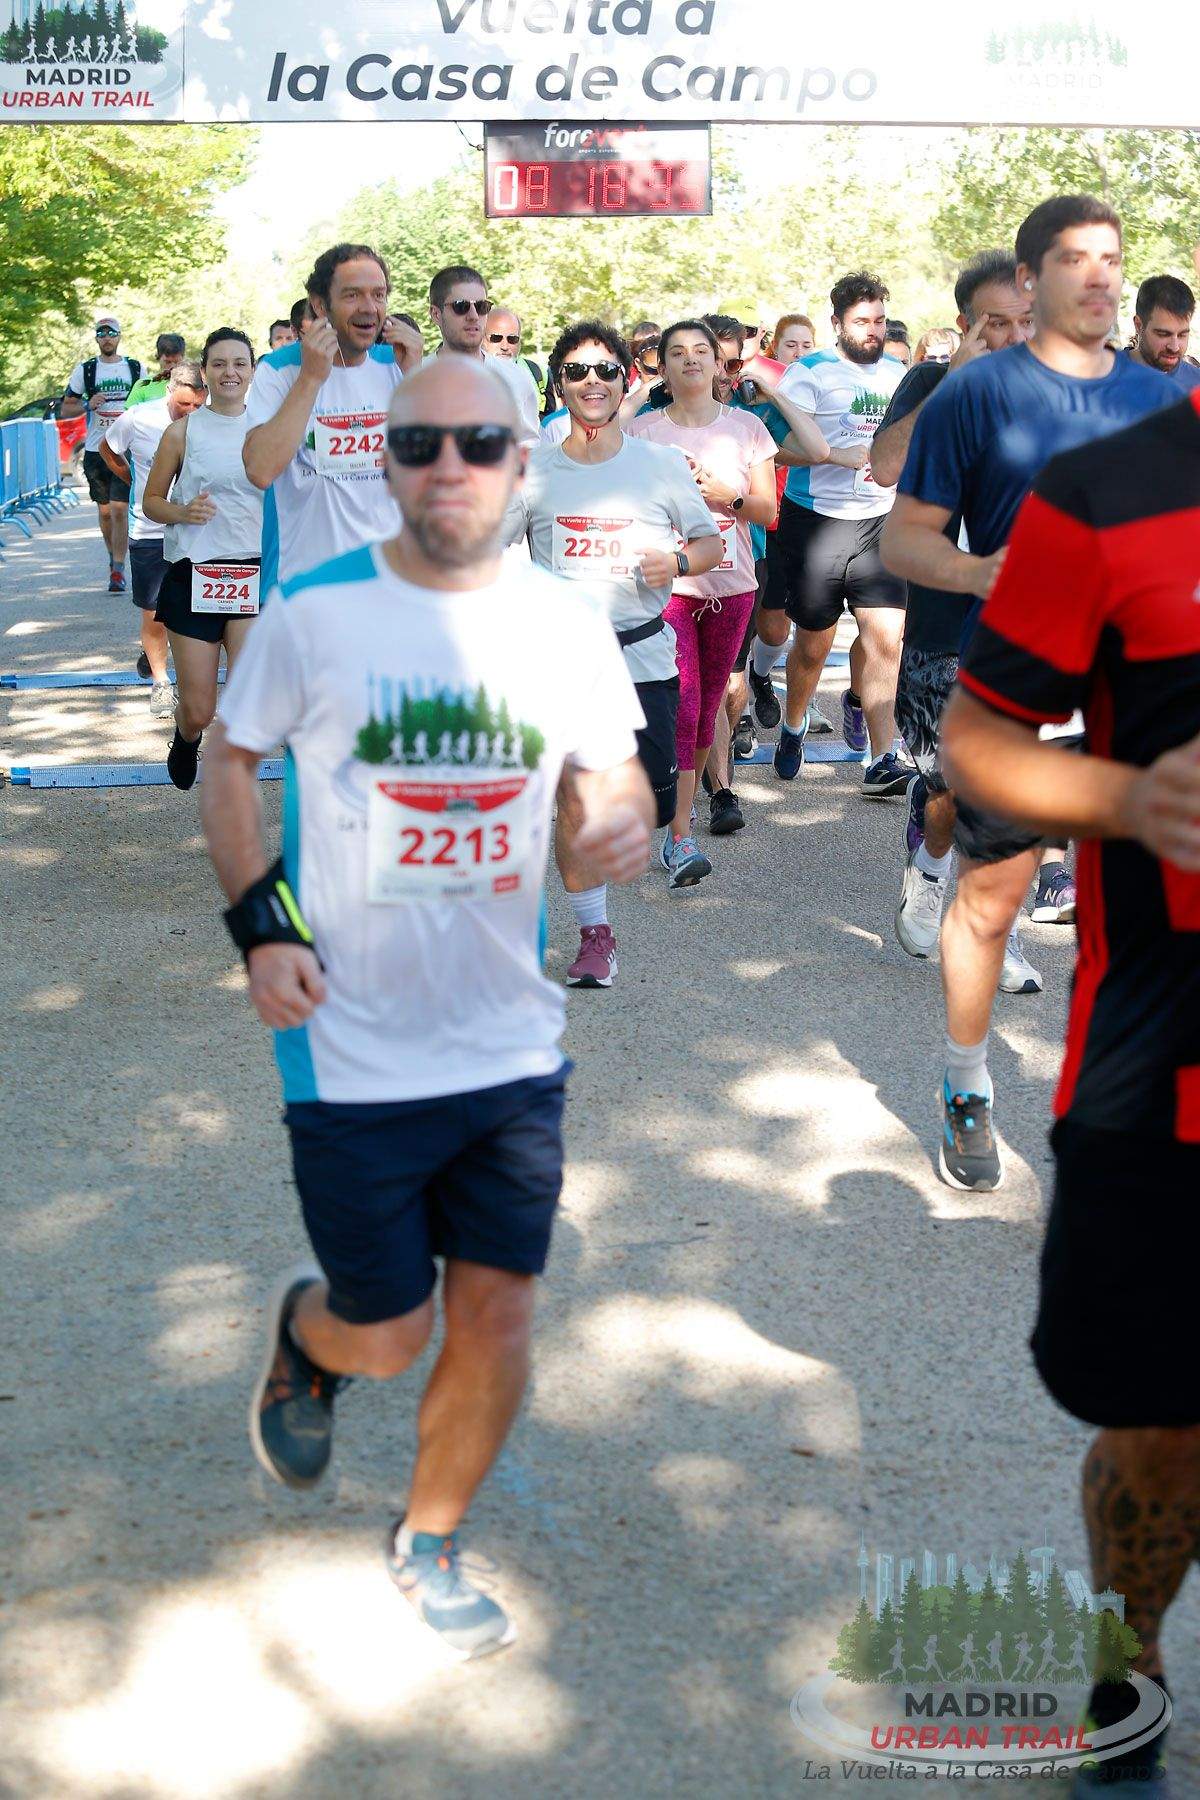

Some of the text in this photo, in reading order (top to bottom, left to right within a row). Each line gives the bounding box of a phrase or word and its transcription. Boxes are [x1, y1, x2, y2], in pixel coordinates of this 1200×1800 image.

[675, 0, 715, 36] a
[26, 68, 131, 85] MADRID
[267, 52, 878, 113] la Casa de Campo
[2, 91, 154, 107] URBAN TRAIL
[329, 433, 385, 456] 2242
[564, 537, 621, 557] 2250
[202, 583, 250, 599] 2224
[398, 823, 510, 865] 2213
